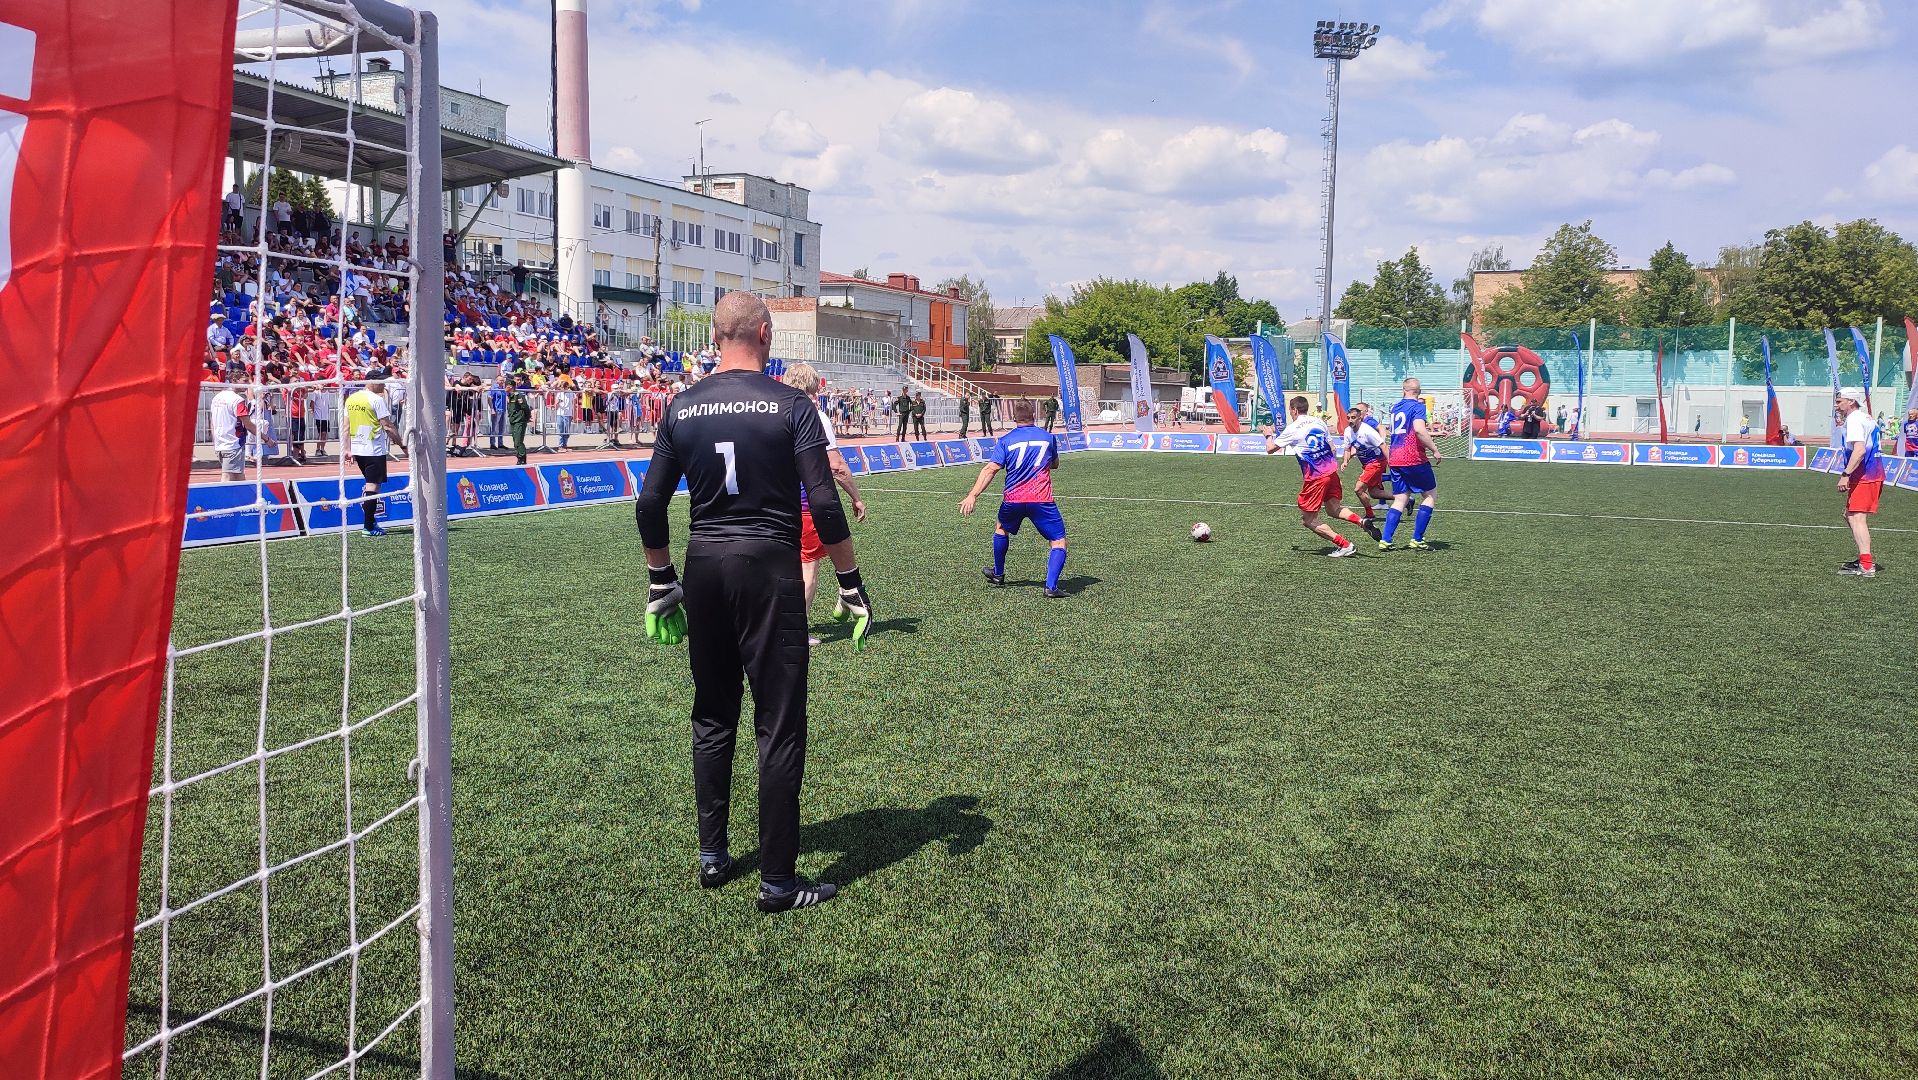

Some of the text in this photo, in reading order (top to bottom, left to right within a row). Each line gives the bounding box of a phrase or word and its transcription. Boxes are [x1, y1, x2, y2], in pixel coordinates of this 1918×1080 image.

[677, 400, 779, 420] ФИЛИМОНОВ
[1390, 411, 1407, 435] 12
[1007, 440, 1050, 469] 77
[714, 441, 740, 495] 1
[479, 482, 509, 492] Команда
[482, 492, 525, 505] Губернатора
